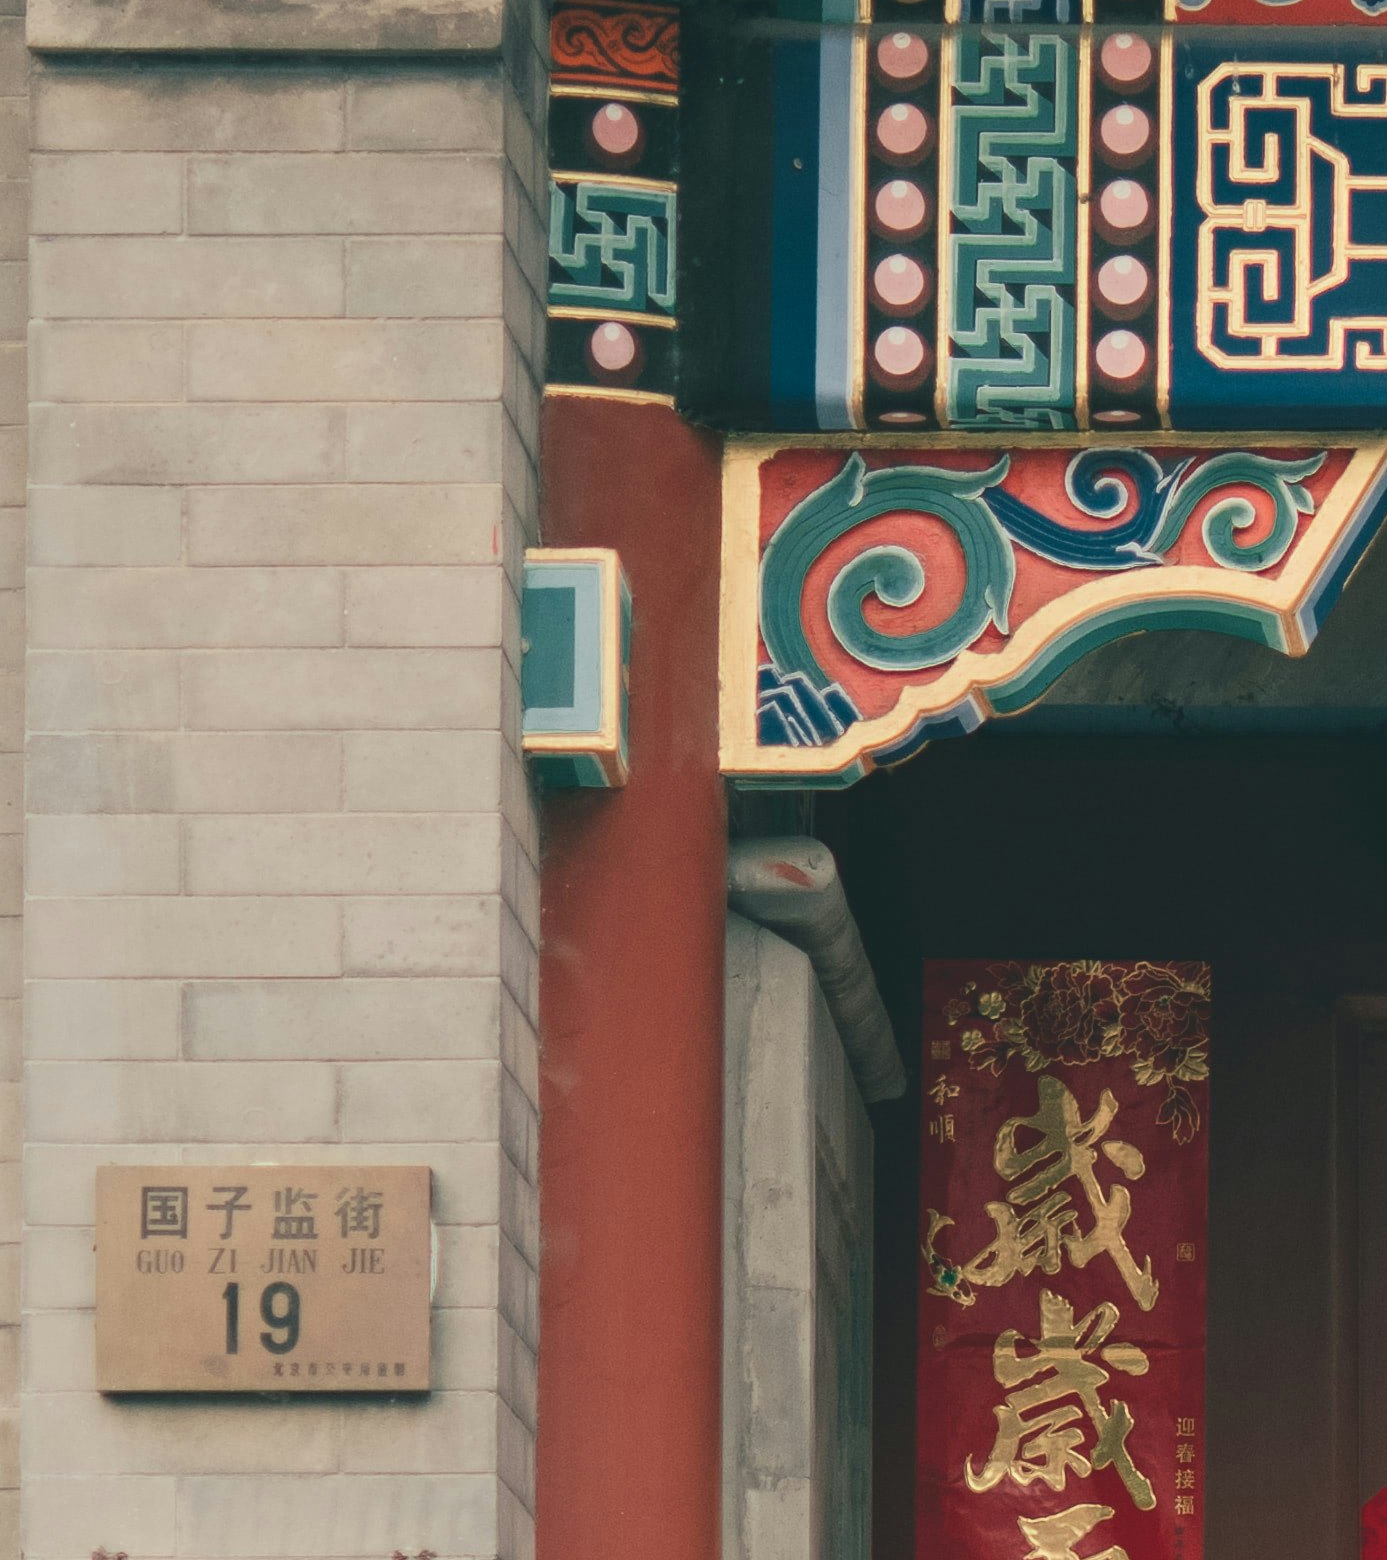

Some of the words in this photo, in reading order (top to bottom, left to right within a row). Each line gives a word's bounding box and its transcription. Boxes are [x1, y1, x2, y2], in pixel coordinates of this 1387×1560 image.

[140, 1186, 384, 1240] 国子监街
[136, 1248, 185, 1275] GUO
[207, 1248, 237, 1275] ZI
[260, 1247, 317, 1275] JIAN
[342, 1247, 385, 1275] JIE
[222, 1281, 301, 1355] 19
[1174, 1417, 1195, 1516] 迎春接福
